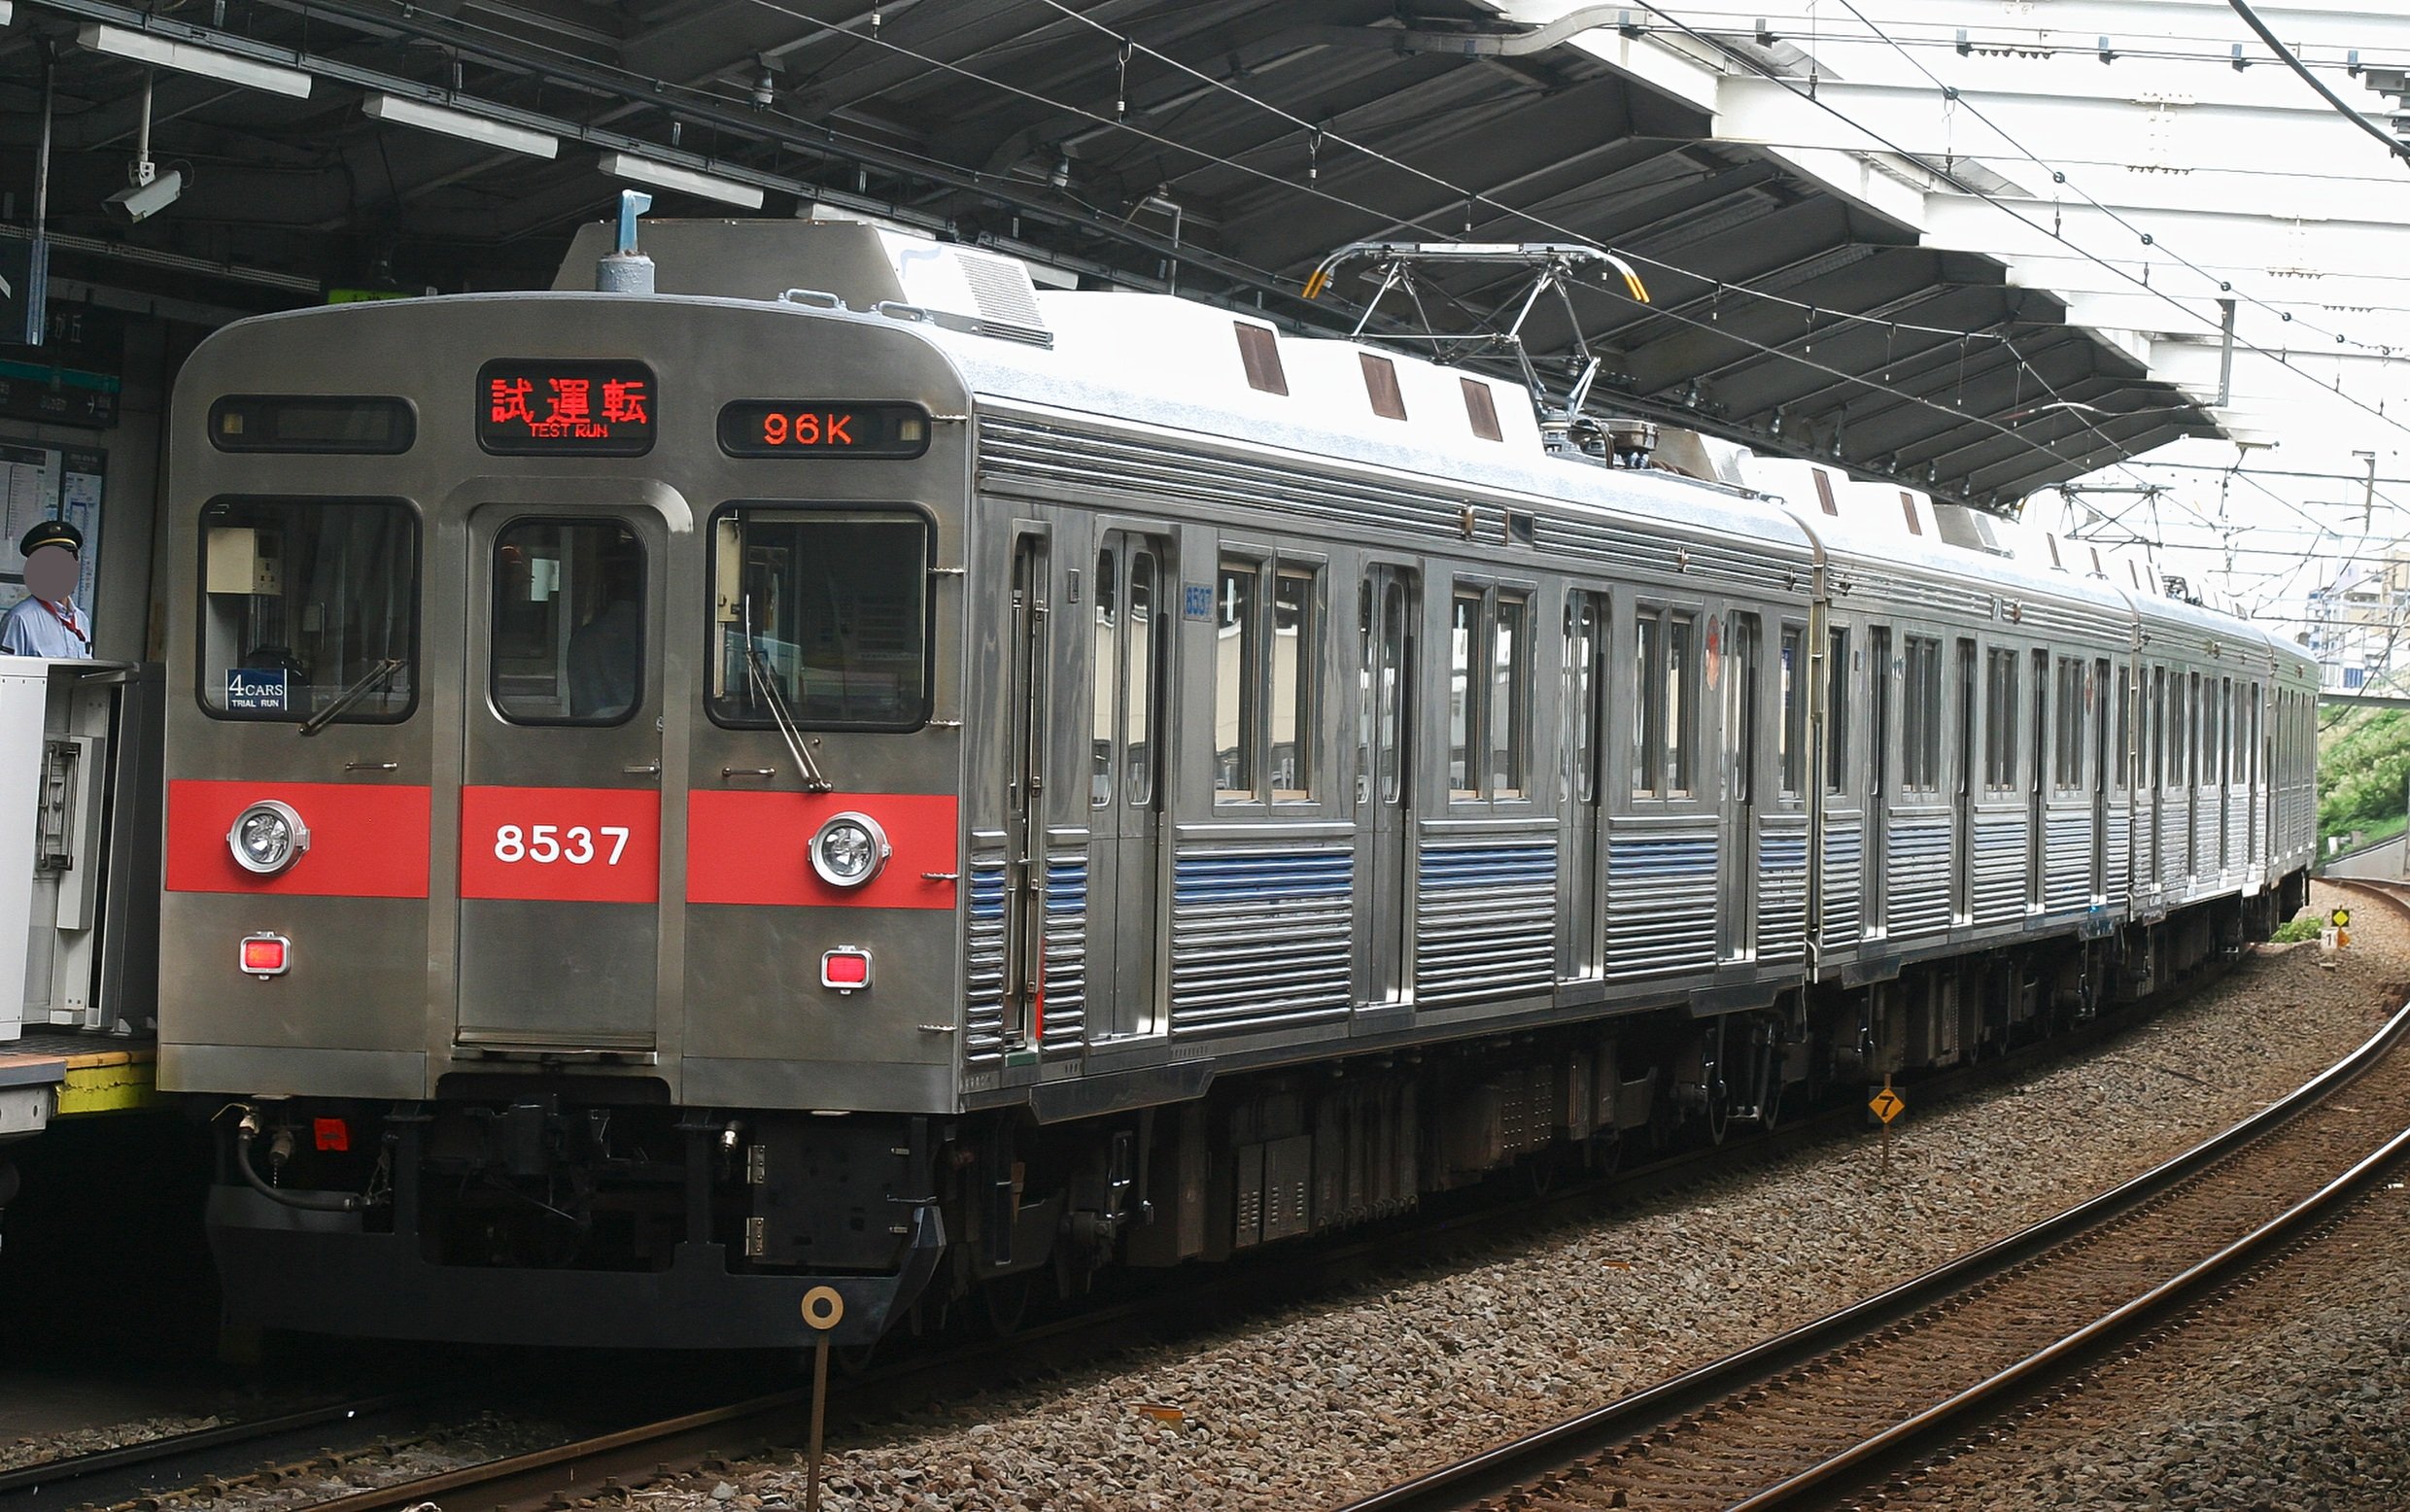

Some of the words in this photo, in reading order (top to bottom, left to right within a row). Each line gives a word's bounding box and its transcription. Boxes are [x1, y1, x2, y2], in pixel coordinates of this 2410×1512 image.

[491, 377, 648, 425] 試運転
[529, 423, 570, 437] TEST
[574, 424, 609, 437] RUN
[764, 413, 853, 445] 96K
[232, 699, 257, 707] TRIAL
[260, 699, 280, 707] RUN
[494, 824, 630, 866] 8537
[1878, 1095, 1895, 1117] 7
